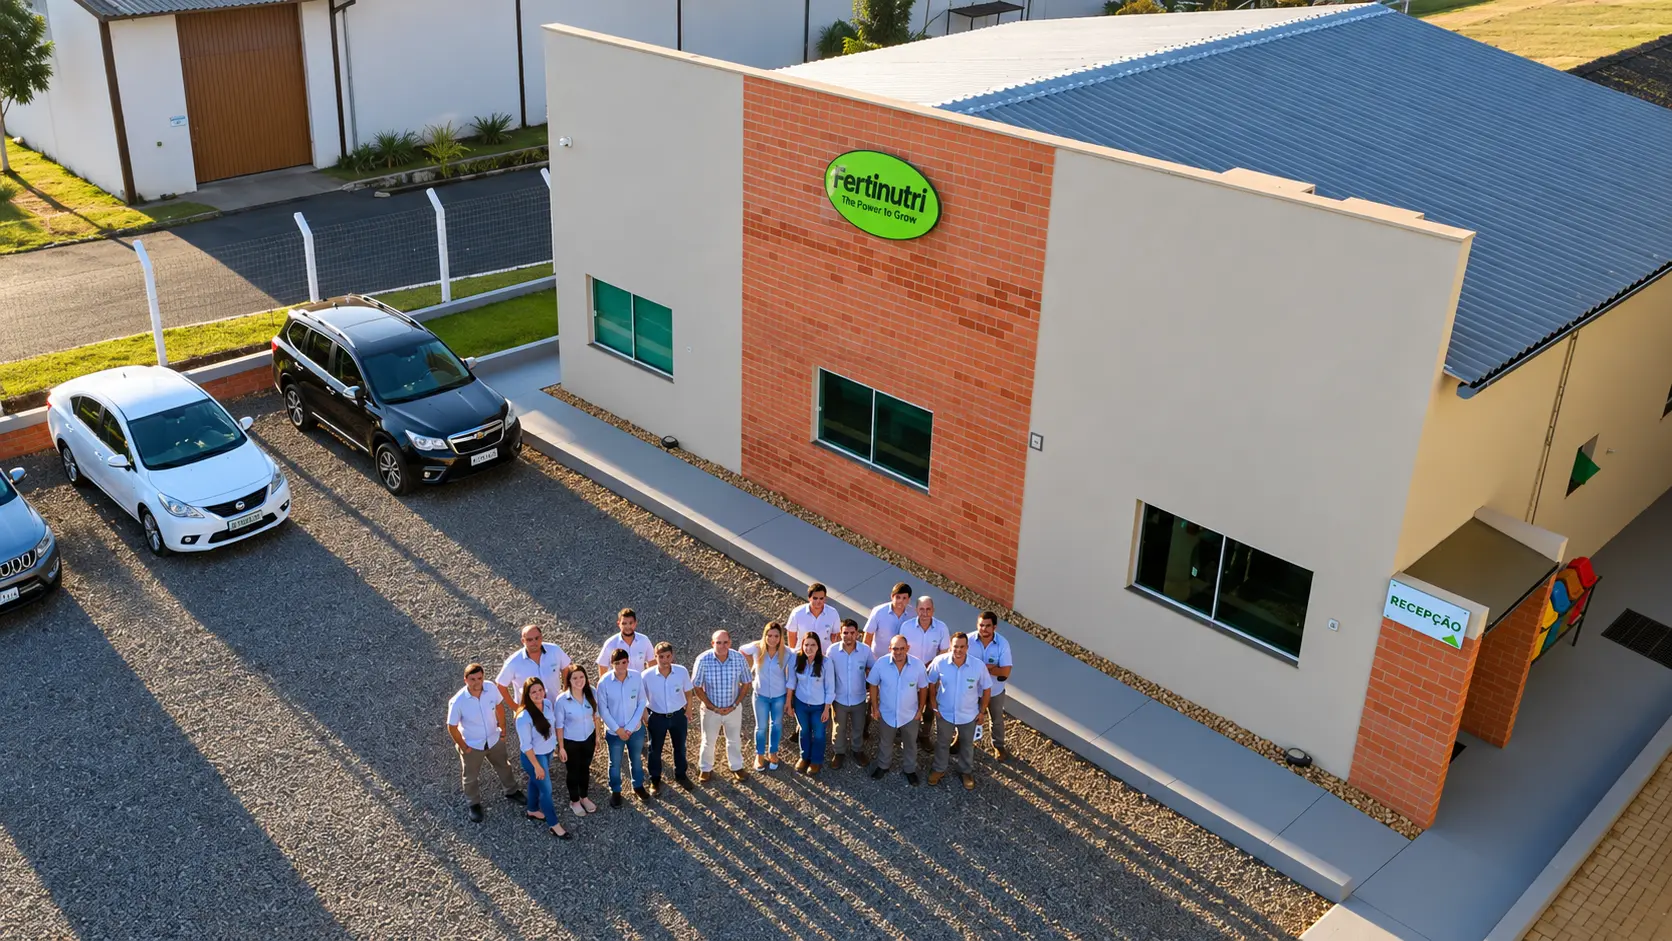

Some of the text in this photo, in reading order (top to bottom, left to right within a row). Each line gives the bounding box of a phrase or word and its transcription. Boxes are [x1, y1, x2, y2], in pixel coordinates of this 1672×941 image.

[833, 165, 927, 213] Fertinutri
[842, 195, 856, 208] The
[857, 200, 882, 214] Power
[894, 210, 917, 224] Grow
[1390, 595, 1462, 632] RECEPÇÃO
